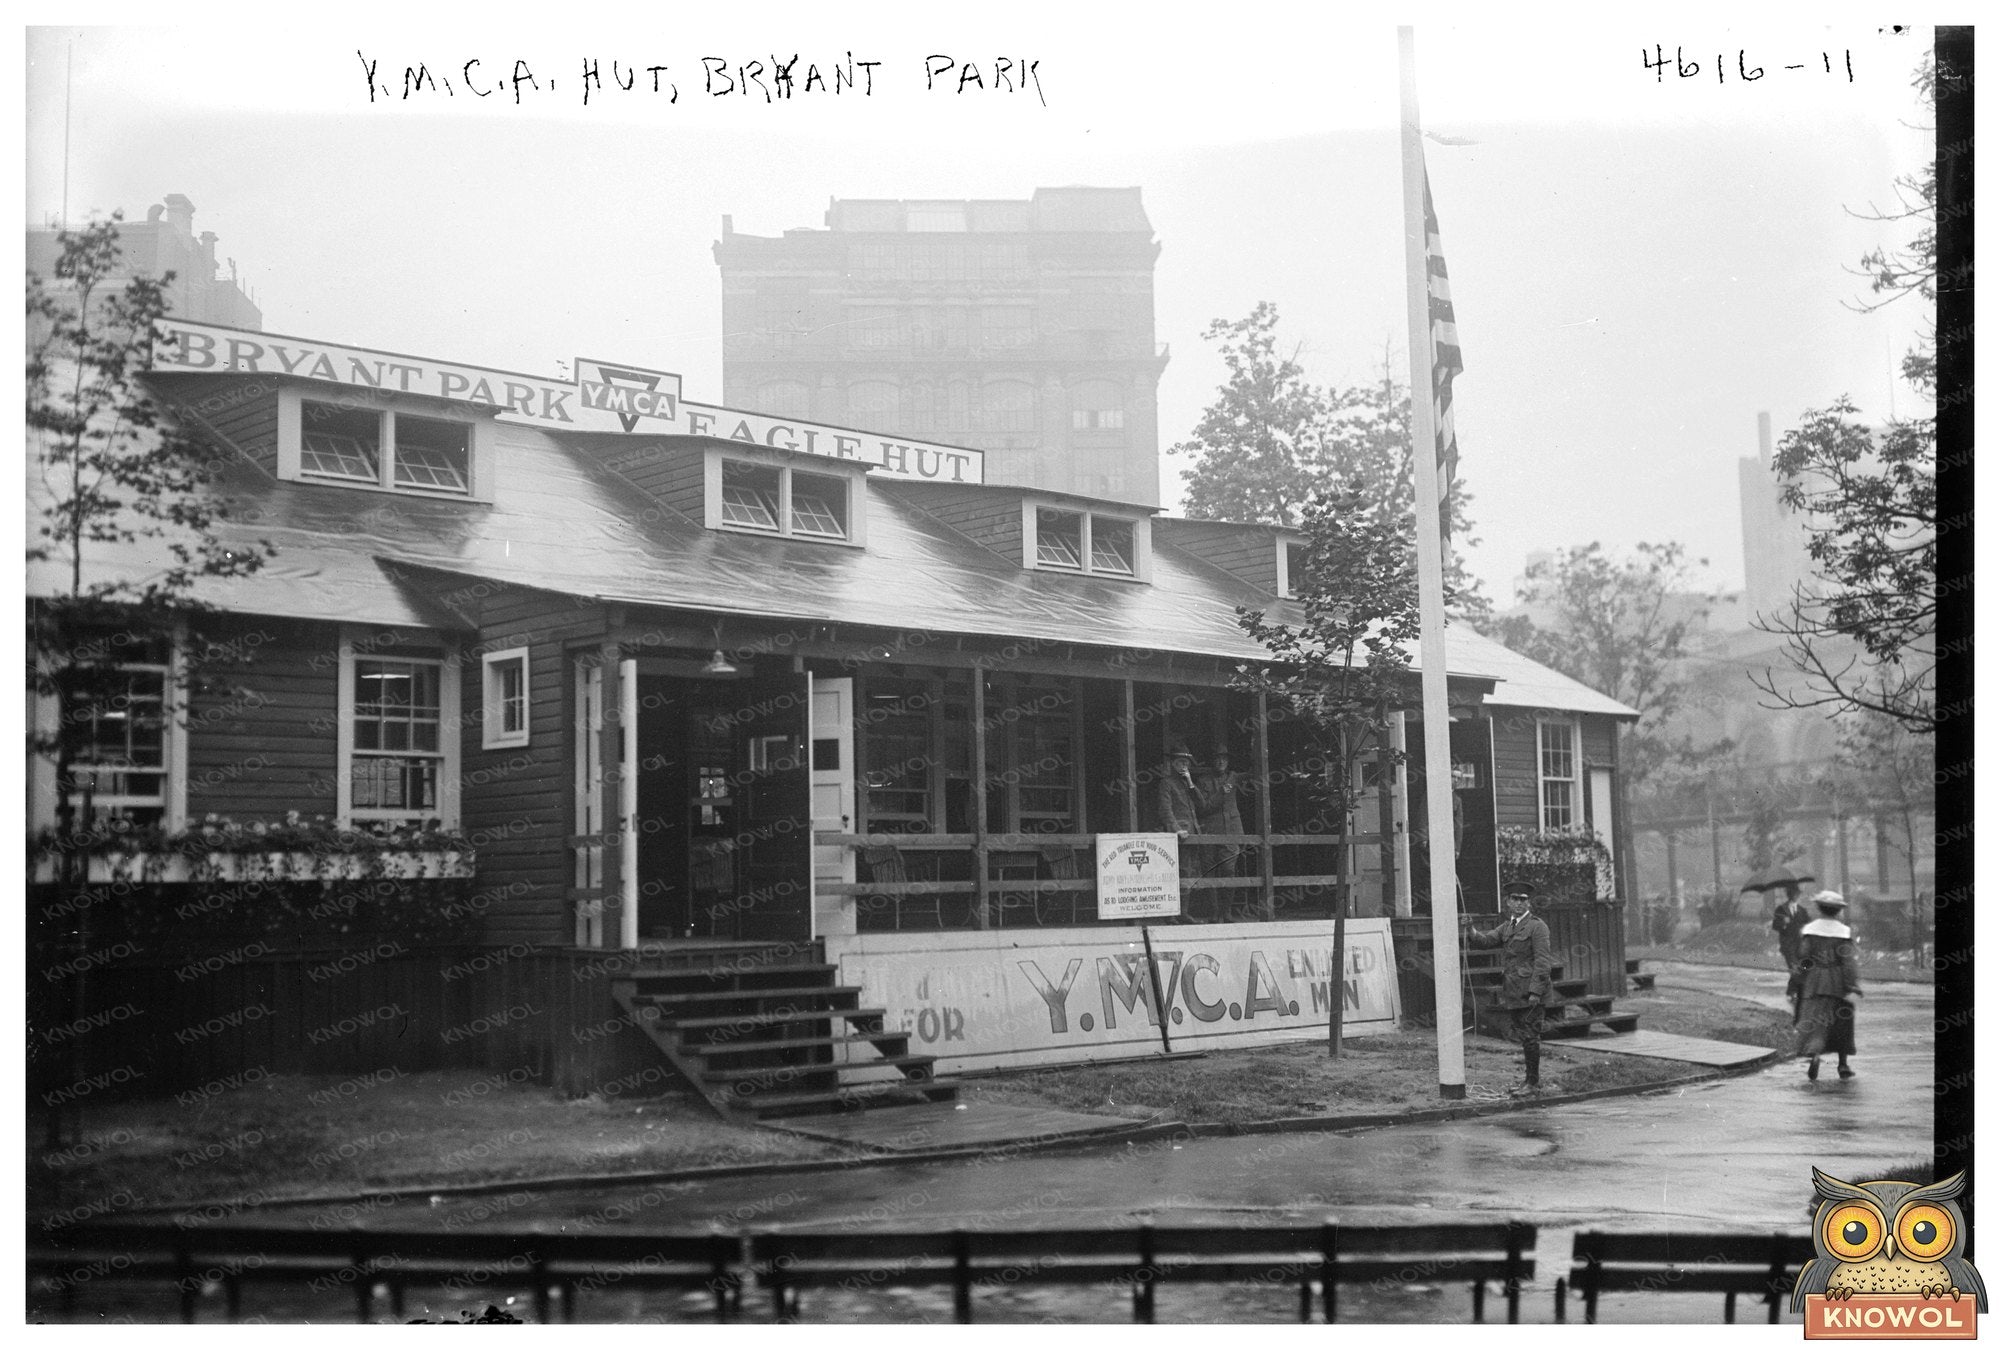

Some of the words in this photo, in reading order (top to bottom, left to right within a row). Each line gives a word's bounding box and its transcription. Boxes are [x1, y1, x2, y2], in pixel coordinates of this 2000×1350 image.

[582, 56, 678, 106] HUT,
[701, 50, 882, 104] BRYANT
[924, 54, 1047, 108] PARK
[1642, 43, 1853, 84] 4616-11
[170, 329, 423, 391] BRYANT
[437, 370, 574, 423] PARK
[584, 383, 673, 419] YMCA
[686, 411, 862, 462] EAGLE
[879, 441, 970, 482] HUT
[1310, 980, 1360, 1014] MN
